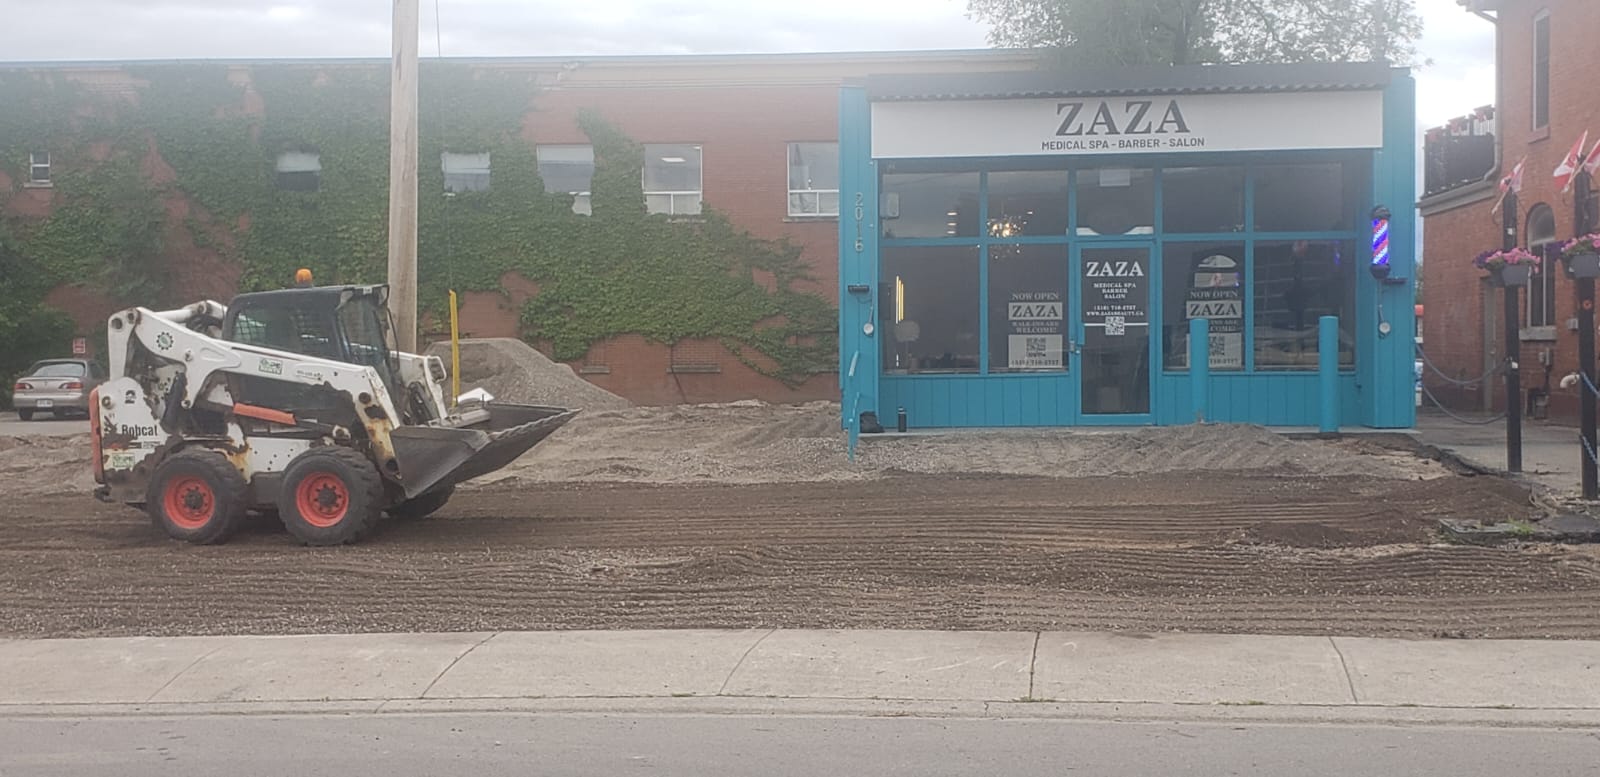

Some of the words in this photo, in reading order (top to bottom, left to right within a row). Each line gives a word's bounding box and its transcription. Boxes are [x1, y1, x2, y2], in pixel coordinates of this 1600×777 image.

[1056, 100, 1190, 136] ZAZA
[1042, 140, 1086, 150] MEDICAL
[1089, 140, 1109, 149] SPA
[1118, 138, 1160, 149] BARBER
[1169, 137, 1205, 148] SALON
[855, 192, 863, 251] 2016
[1086, 261, 1144, 276] ZAZA
[1012, 292, 1032, 300] NOW
[1034, 292, 1059, 300] OPEN
[1190, 291, 1210, 299] NOW
[1213, 290, 1238, 298] OPEN
[1012, 305, 1059, 318] ZAZA
[1190, 303, 1237, 317] ZAZA
[121, 424, 158, 437] Bobcat
